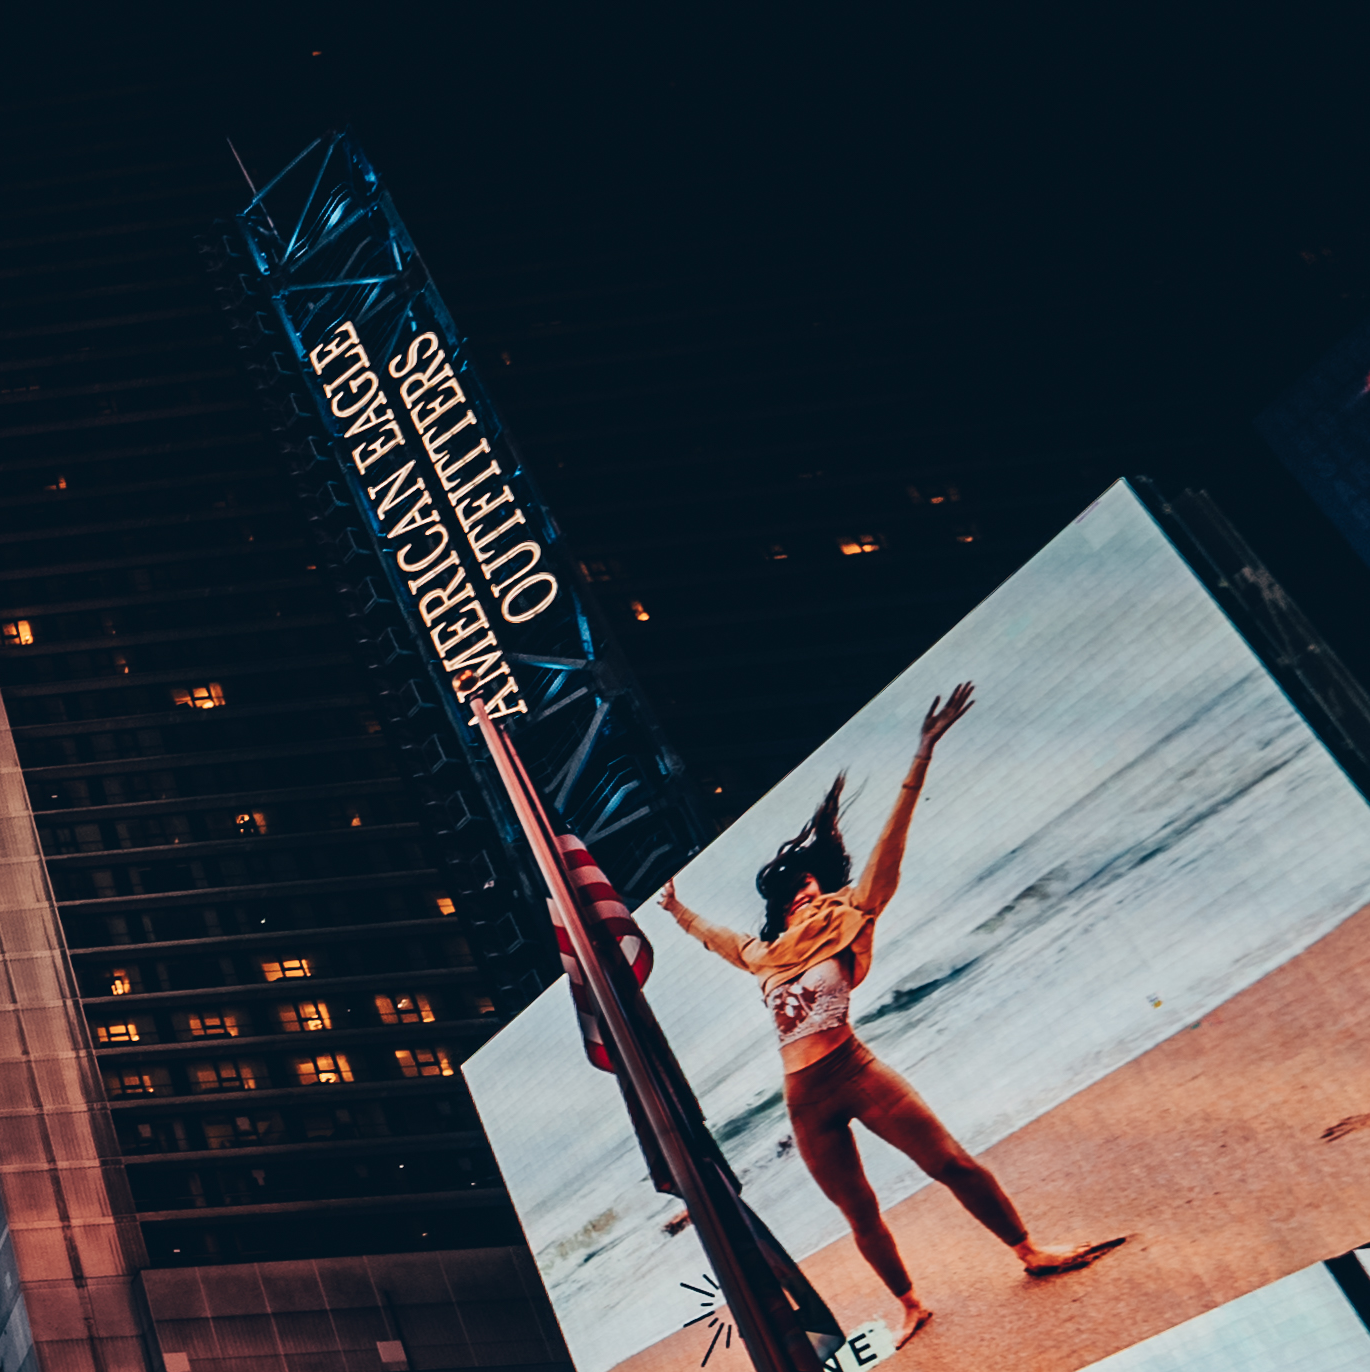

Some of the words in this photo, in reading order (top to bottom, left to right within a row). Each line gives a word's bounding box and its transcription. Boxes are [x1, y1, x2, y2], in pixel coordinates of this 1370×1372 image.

[308, 319, 406, 474] EAGLE
[388, 330, 558, 624] OUTFITTERS
[368, 459, 529, 727] AMERICAN
